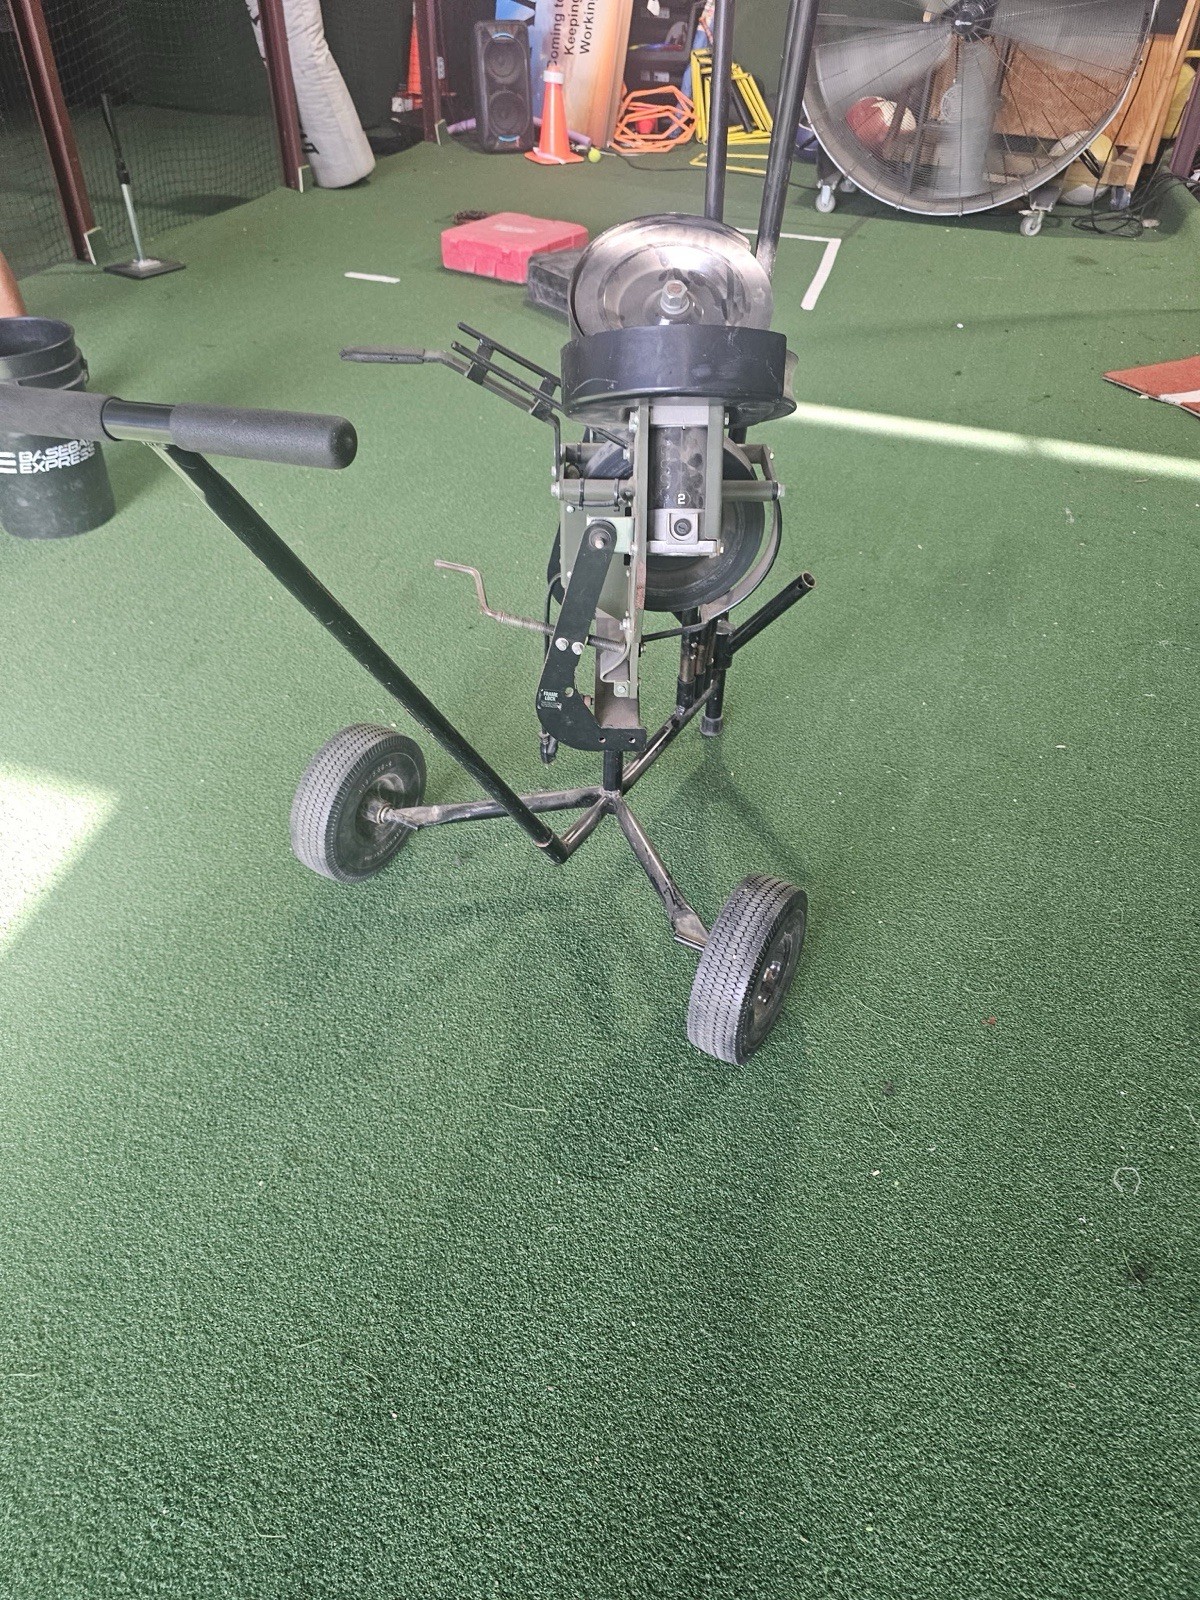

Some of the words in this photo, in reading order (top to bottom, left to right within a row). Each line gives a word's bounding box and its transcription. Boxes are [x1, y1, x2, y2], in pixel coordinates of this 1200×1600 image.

[580, 0, 597, 54] Workin
[18, 439, 94, 463] BASEBA
[677, 493, 686, 505] 2
